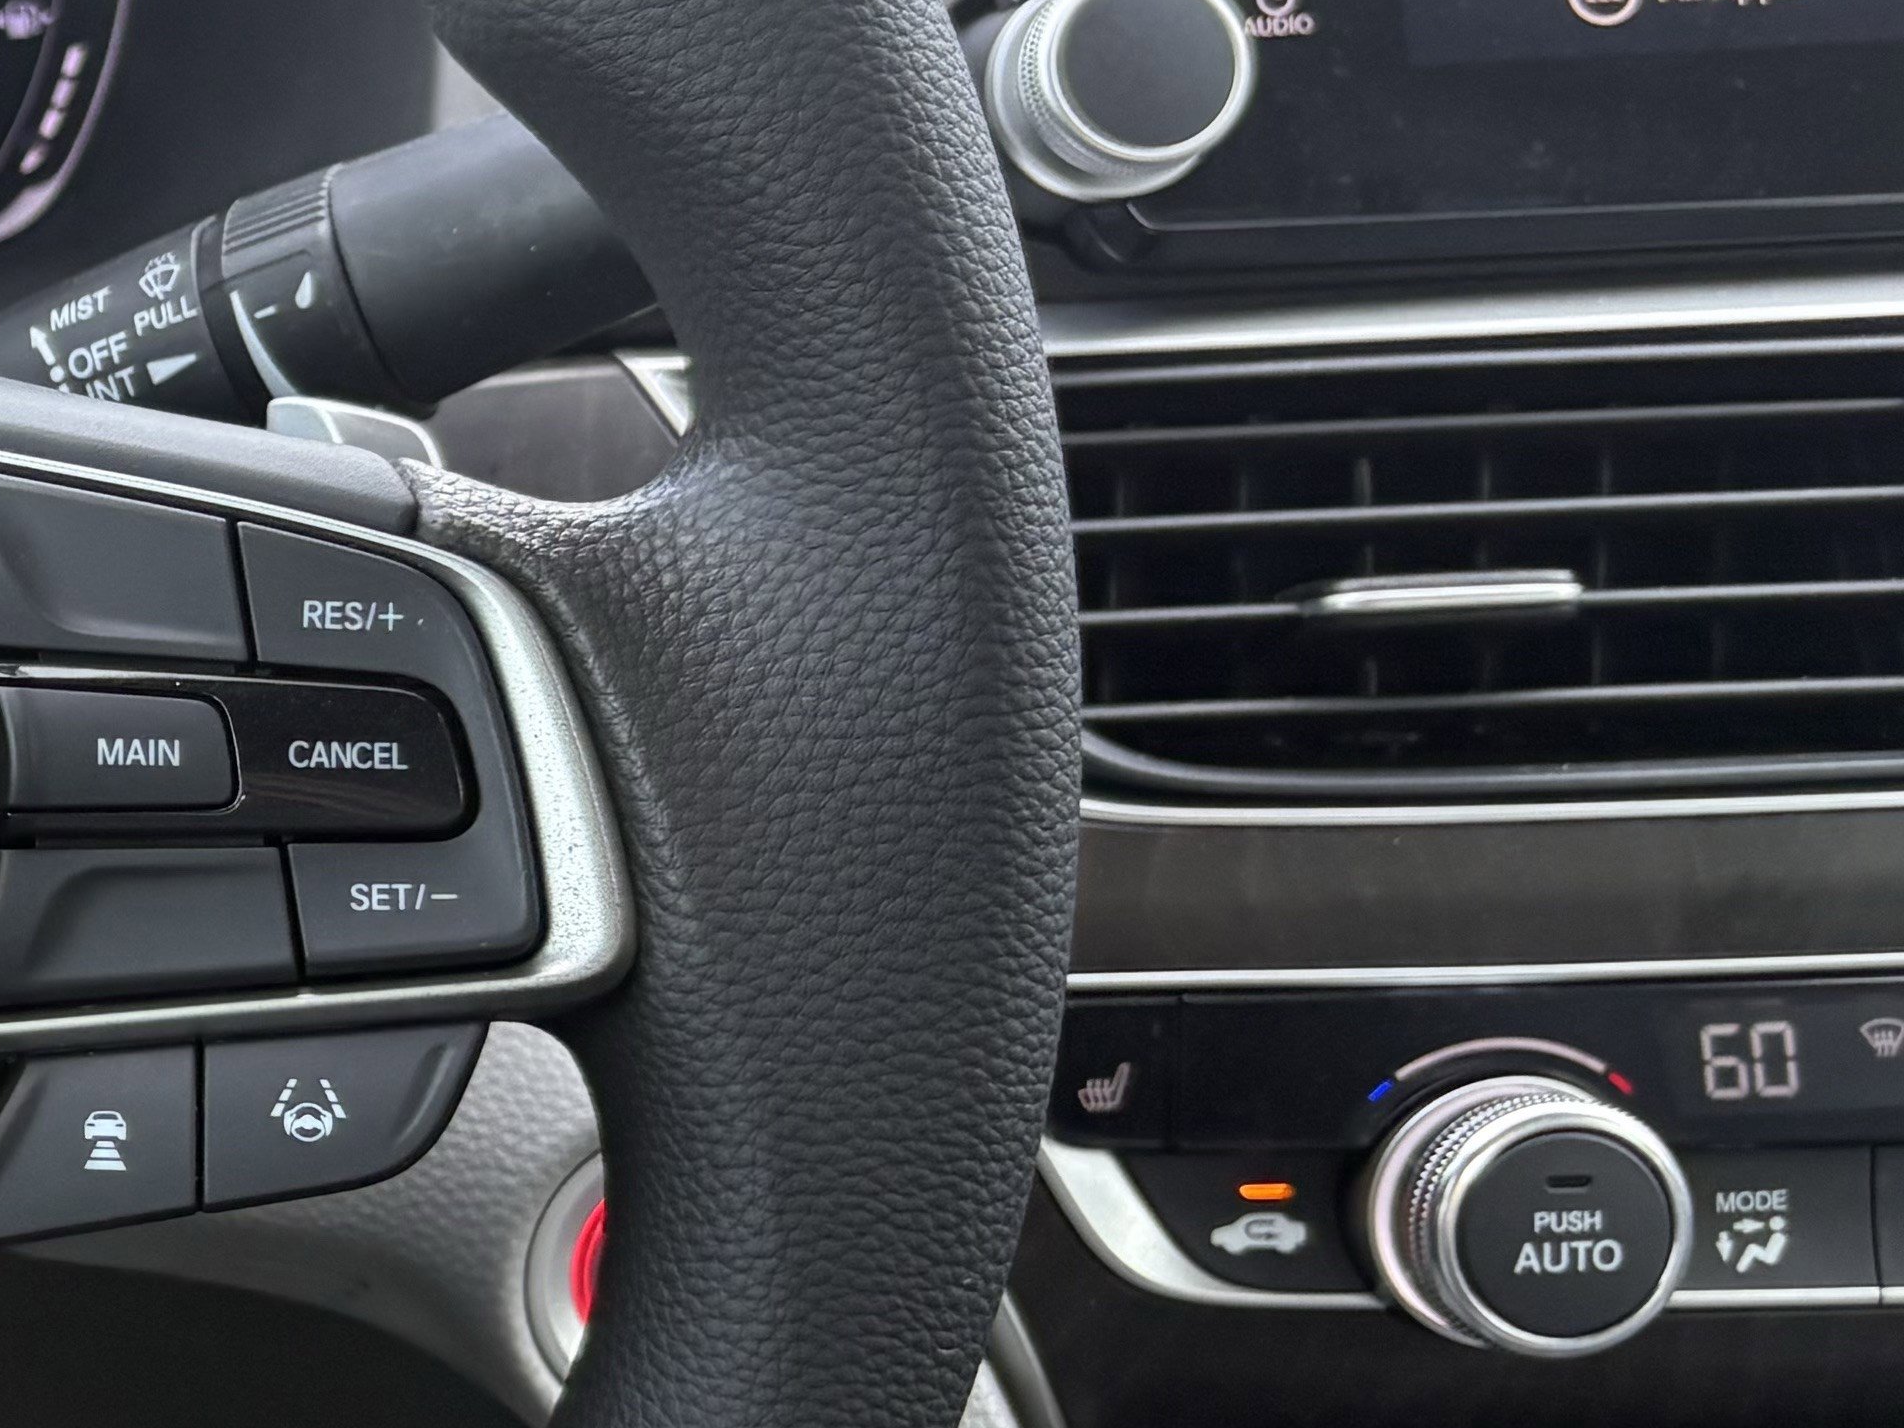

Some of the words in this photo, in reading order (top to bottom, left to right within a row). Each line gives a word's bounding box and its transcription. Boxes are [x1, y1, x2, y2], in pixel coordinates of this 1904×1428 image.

[1245, 12, 1315, 38] AUDIO
[49, 285, 113, 332] MIST
[133, 294, 200, 337] PULL
[67, 330, 130, 380] OFF
[84, 364, 137, 402] INT
[301, 600, 405, 633] RES/+
[96, 737, 182, 768] MAIN
[287, 740, 410, 772] CANCEL
[1700, 1020, 1800, 1100] 60
[1714, 1188, 1790, 1214] MODE
[1533, 1209, 1603, 1234] PUSH
[1513, 1238, 1624, 1275] AUTO
